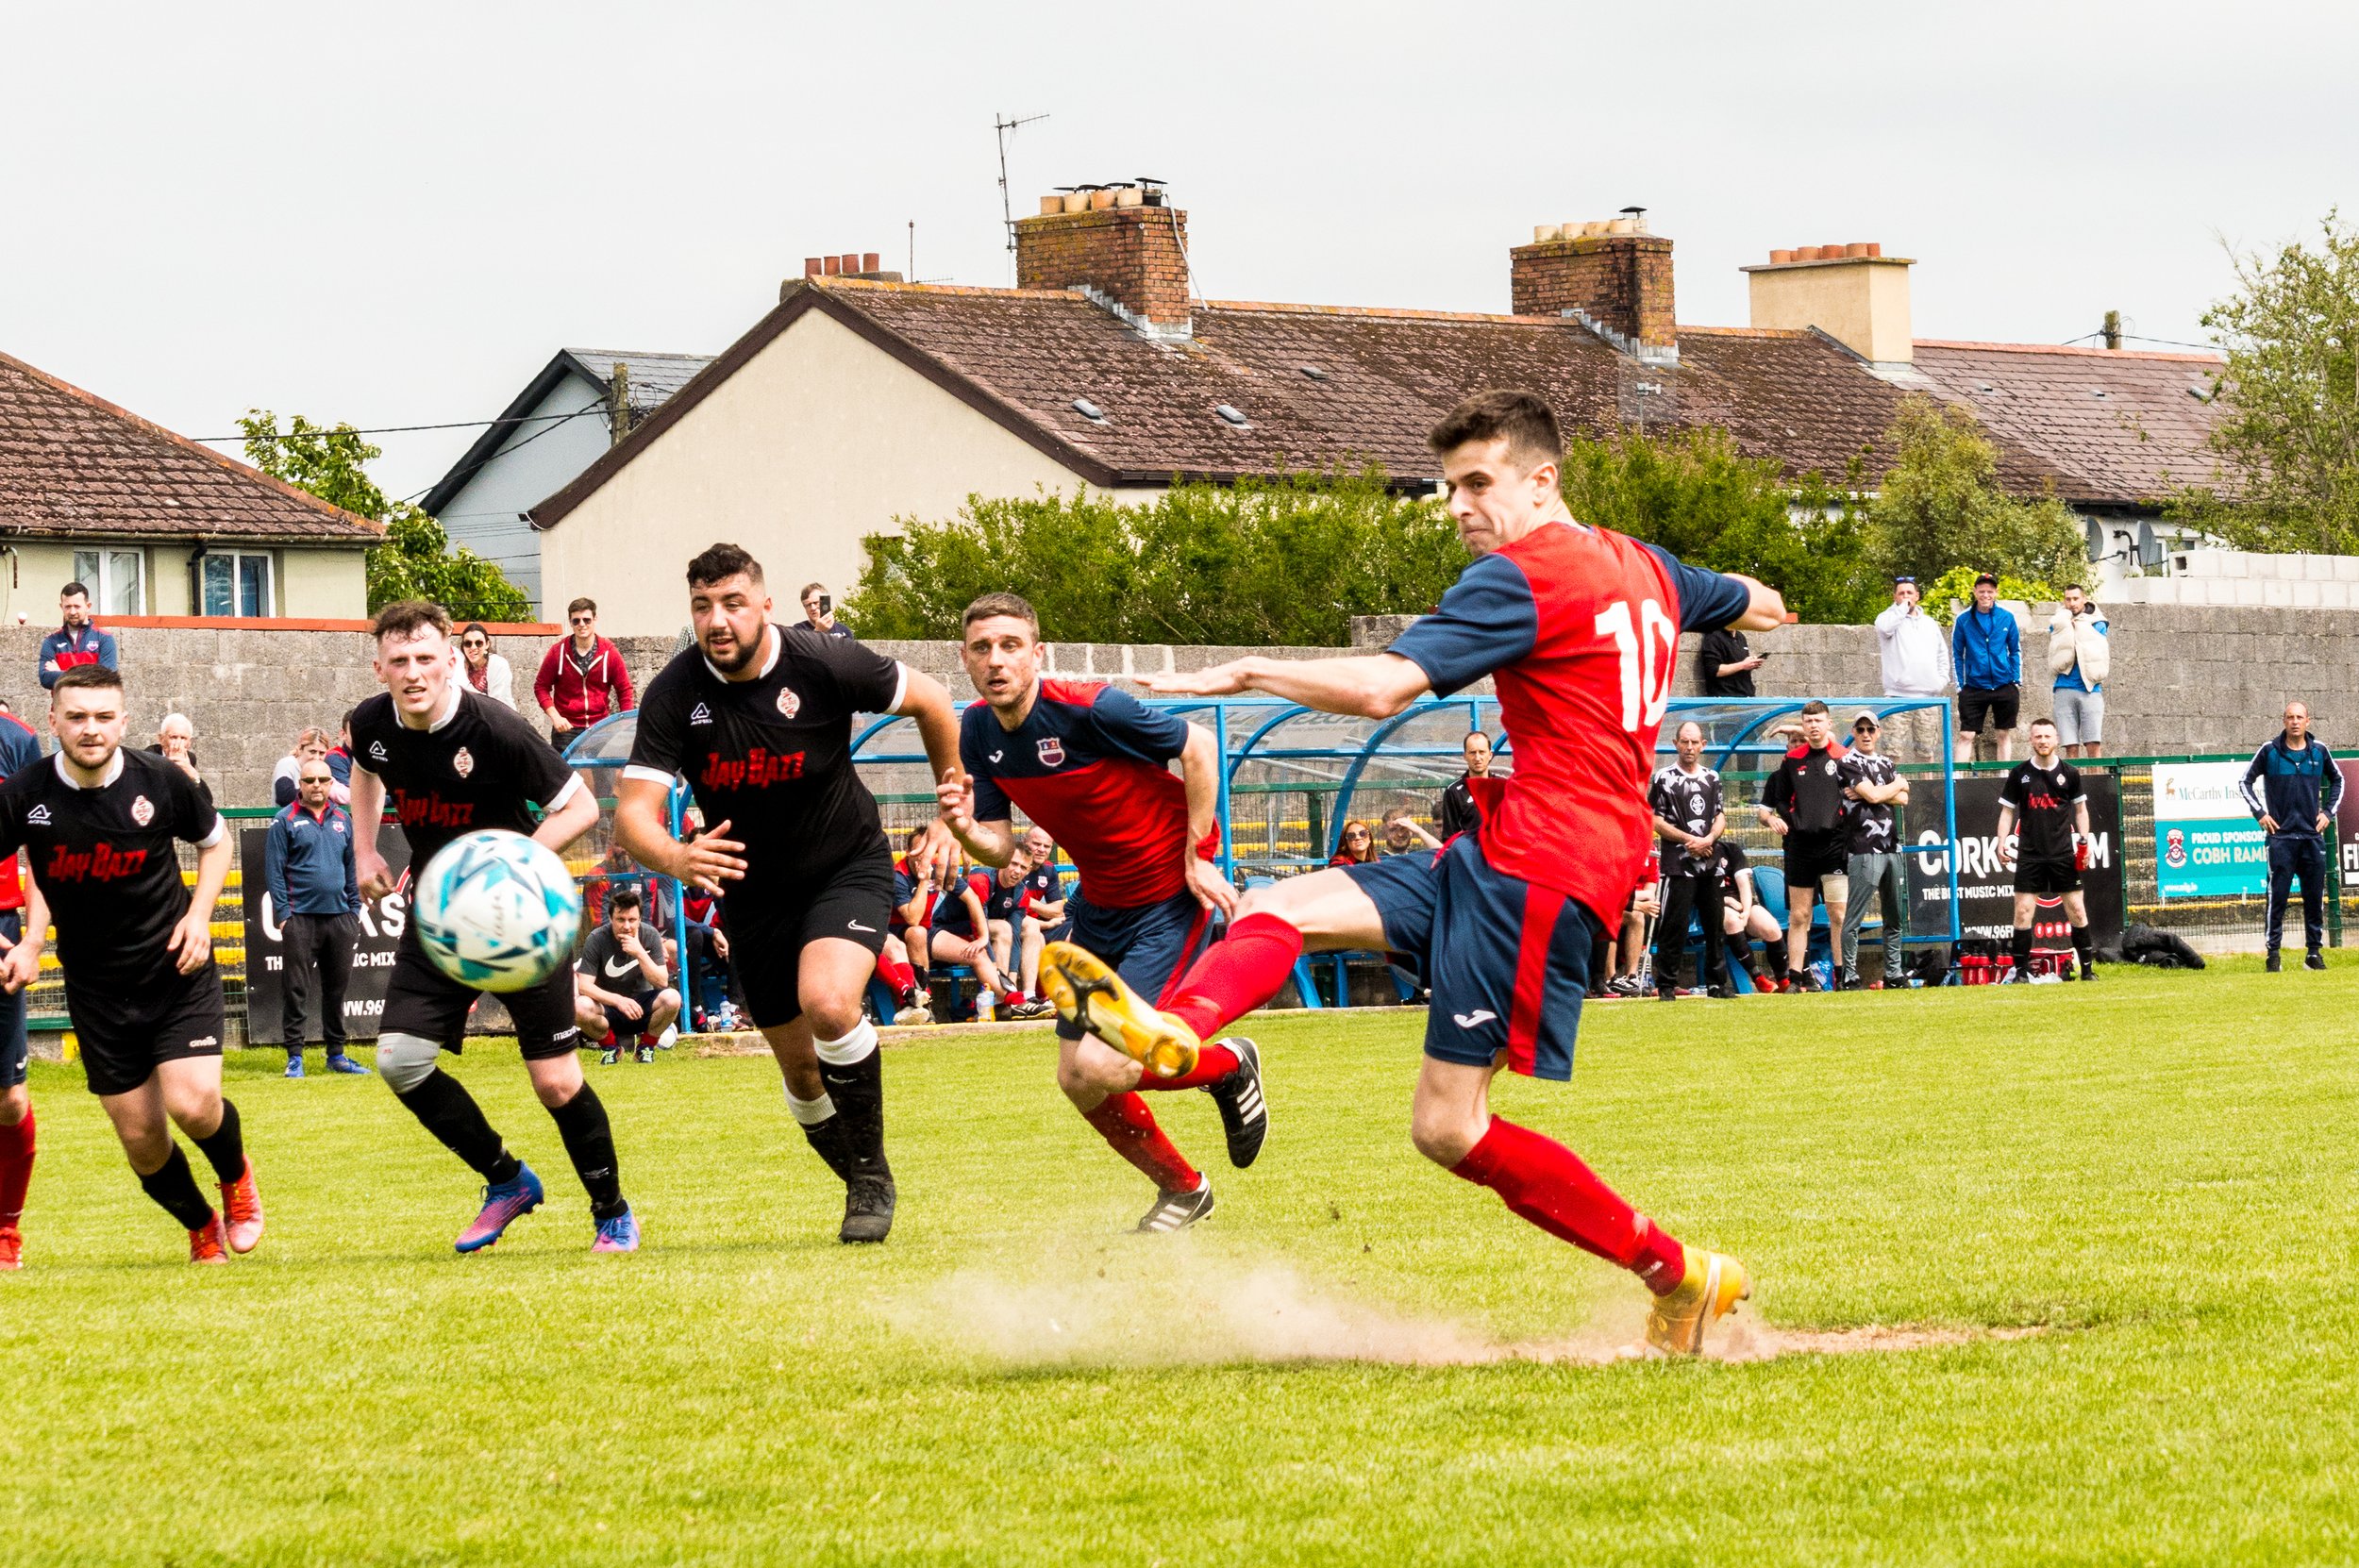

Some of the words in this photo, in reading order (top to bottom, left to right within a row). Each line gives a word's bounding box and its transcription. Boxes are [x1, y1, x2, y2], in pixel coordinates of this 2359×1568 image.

[1595, 598, 1676, 732] 10
[2179, 786, 2222, 805] McCarthy
[2191, 832, 2221, 844] PROUD
[2192, 847, 2231, 865] COBH
[2343, 843, 2359, 870] FI
[1922, 888, 1940, 900] THE
[1965, 885, 1996, 899] MUSIC
[1997, 884, 2016, 898] MIX
[371, 951, 396, 967] MIX
